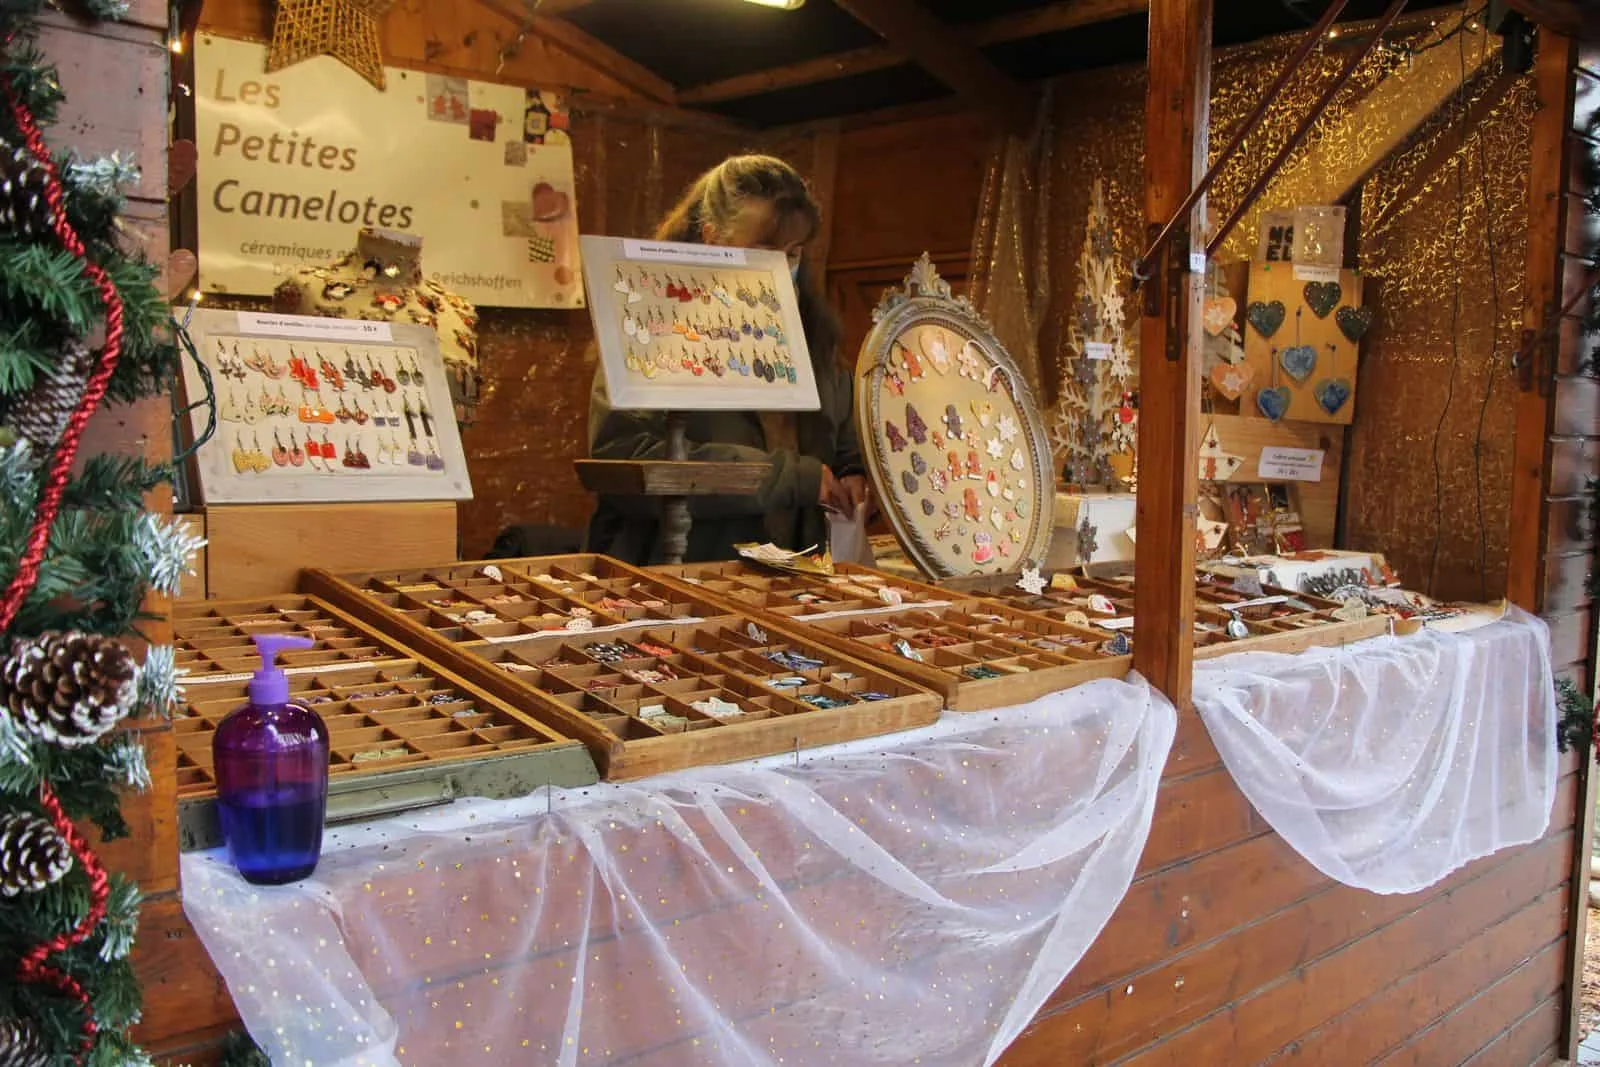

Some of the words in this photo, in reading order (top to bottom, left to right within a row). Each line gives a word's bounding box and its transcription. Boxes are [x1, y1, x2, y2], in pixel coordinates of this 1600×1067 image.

[214, 68, 281, 109] Les
[213, 122, 358, 171] Petites
[213, 178, 414, 229] Camelotes
[240, 240, 332, 261] céramiques
